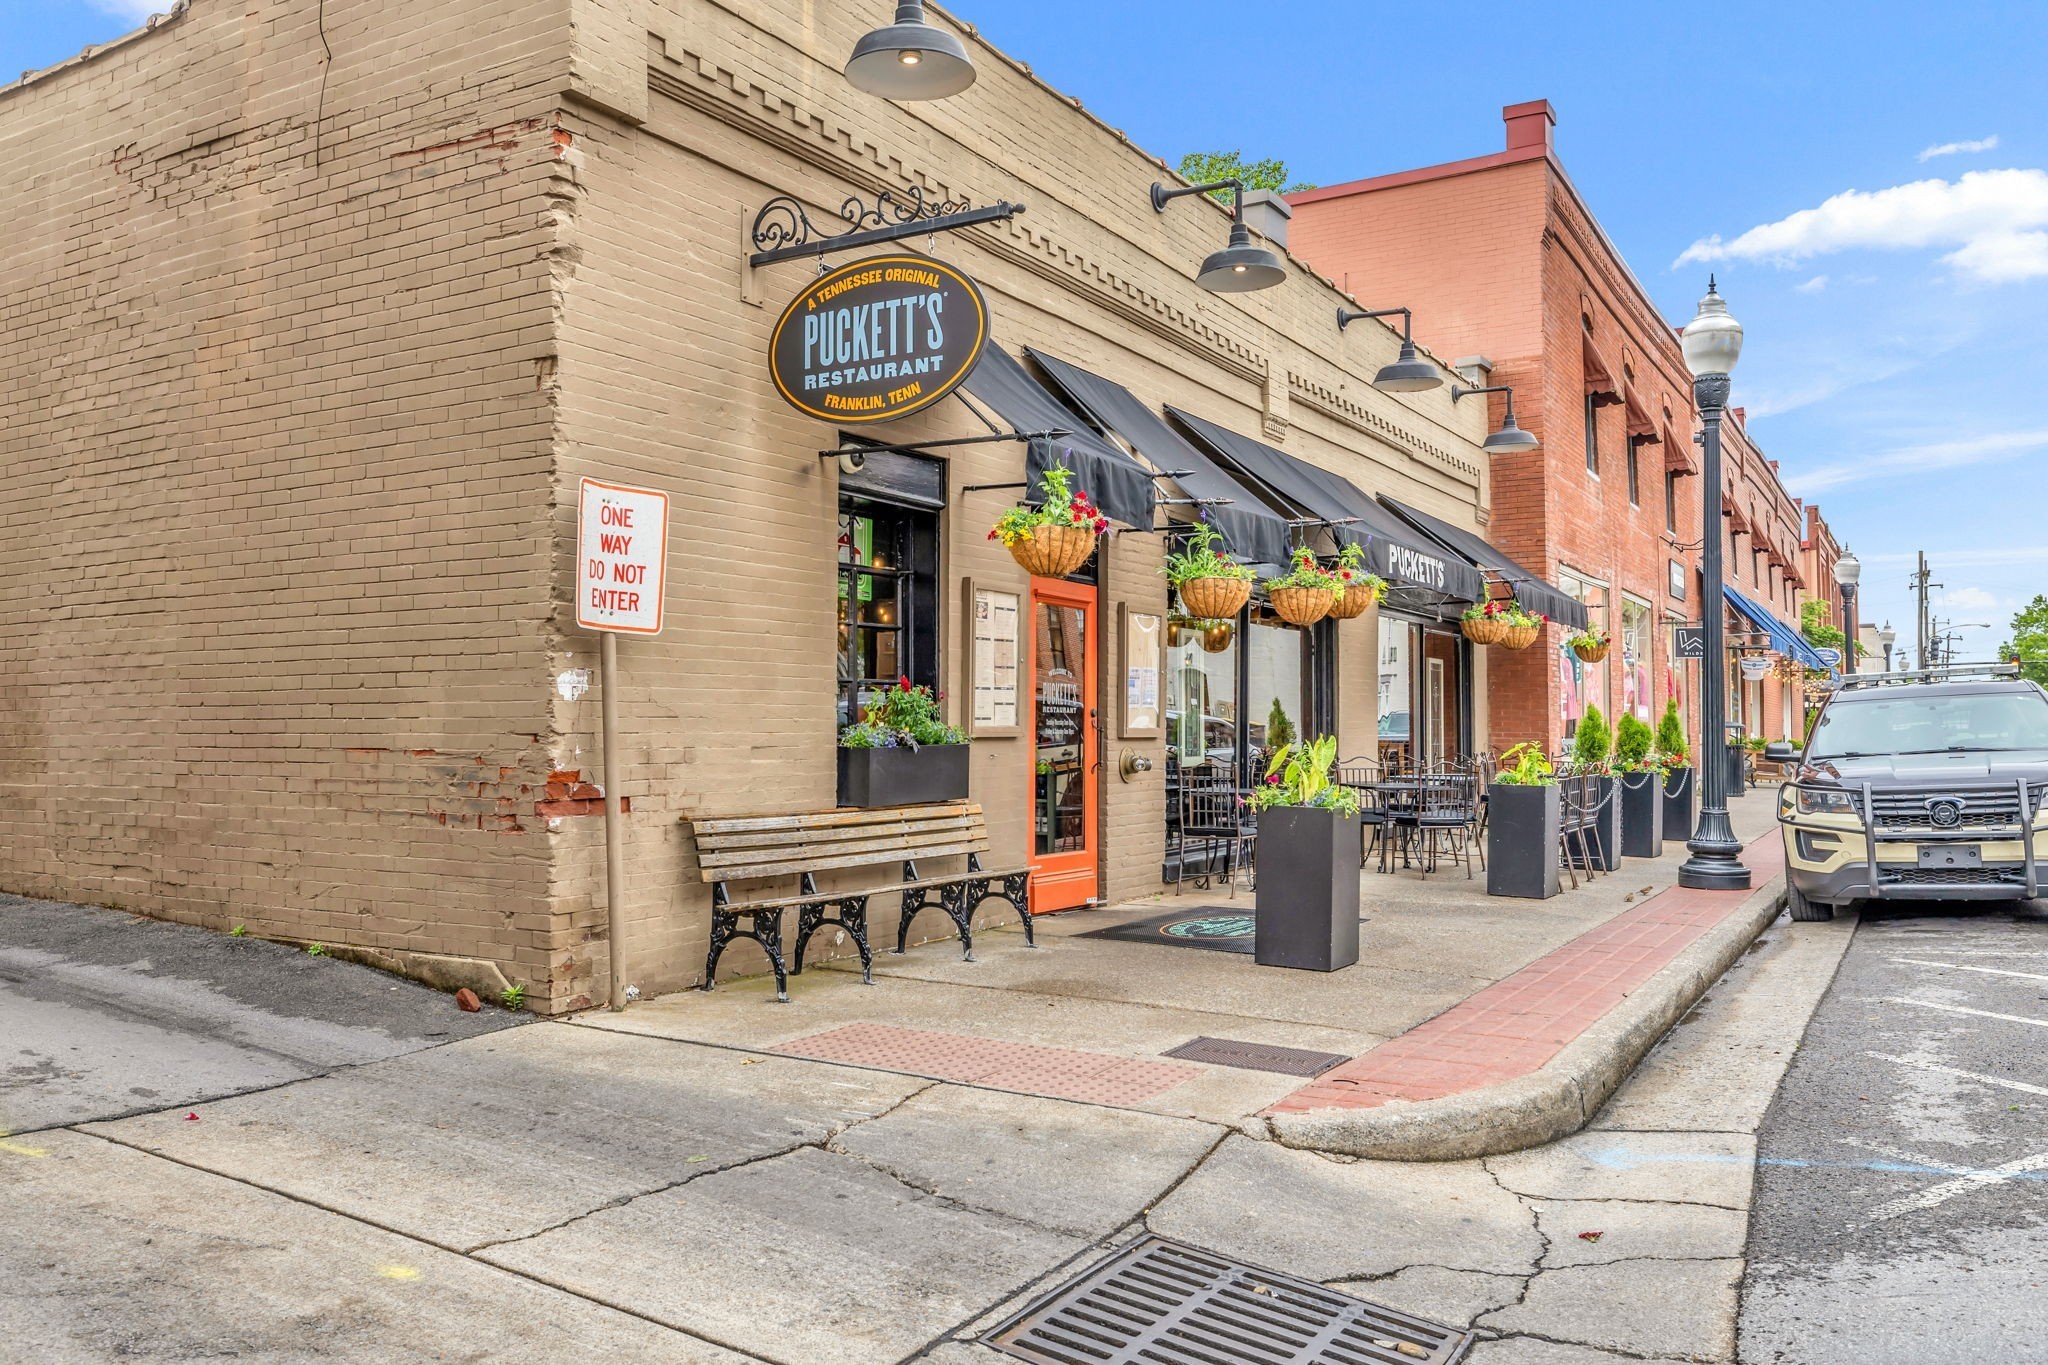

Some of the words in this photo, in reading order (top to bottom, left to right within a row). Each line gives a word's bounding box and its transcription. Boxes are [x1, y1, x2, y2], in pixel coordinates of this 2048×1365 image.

[807, 297, 817, 311] A
[816, 269, 883, 303] TENNESSEE
[884, 268, 940, 289] ORIGINAL
[804, 292, 944, 370] PUCKETT'S
[804, 355, 944, 390] RESTAURANT
[824, 393, 886, 410] FRANKLIN,
[887, 381, 921, 405] TENN
[600, 505, 634, 528] ONE
[600, 533, 632, 556] WAY
[589, 558, 605, 580] DO
[613, 563, 646, 585] NOT
[1388, 543, 1445, 588] PUCKETT'S
[591, 587, 639, 612] ENTER
[1042, 682, 1077, 706] PUCKETT'S
[1042, 706, 1077, 714] RESTAURANT
